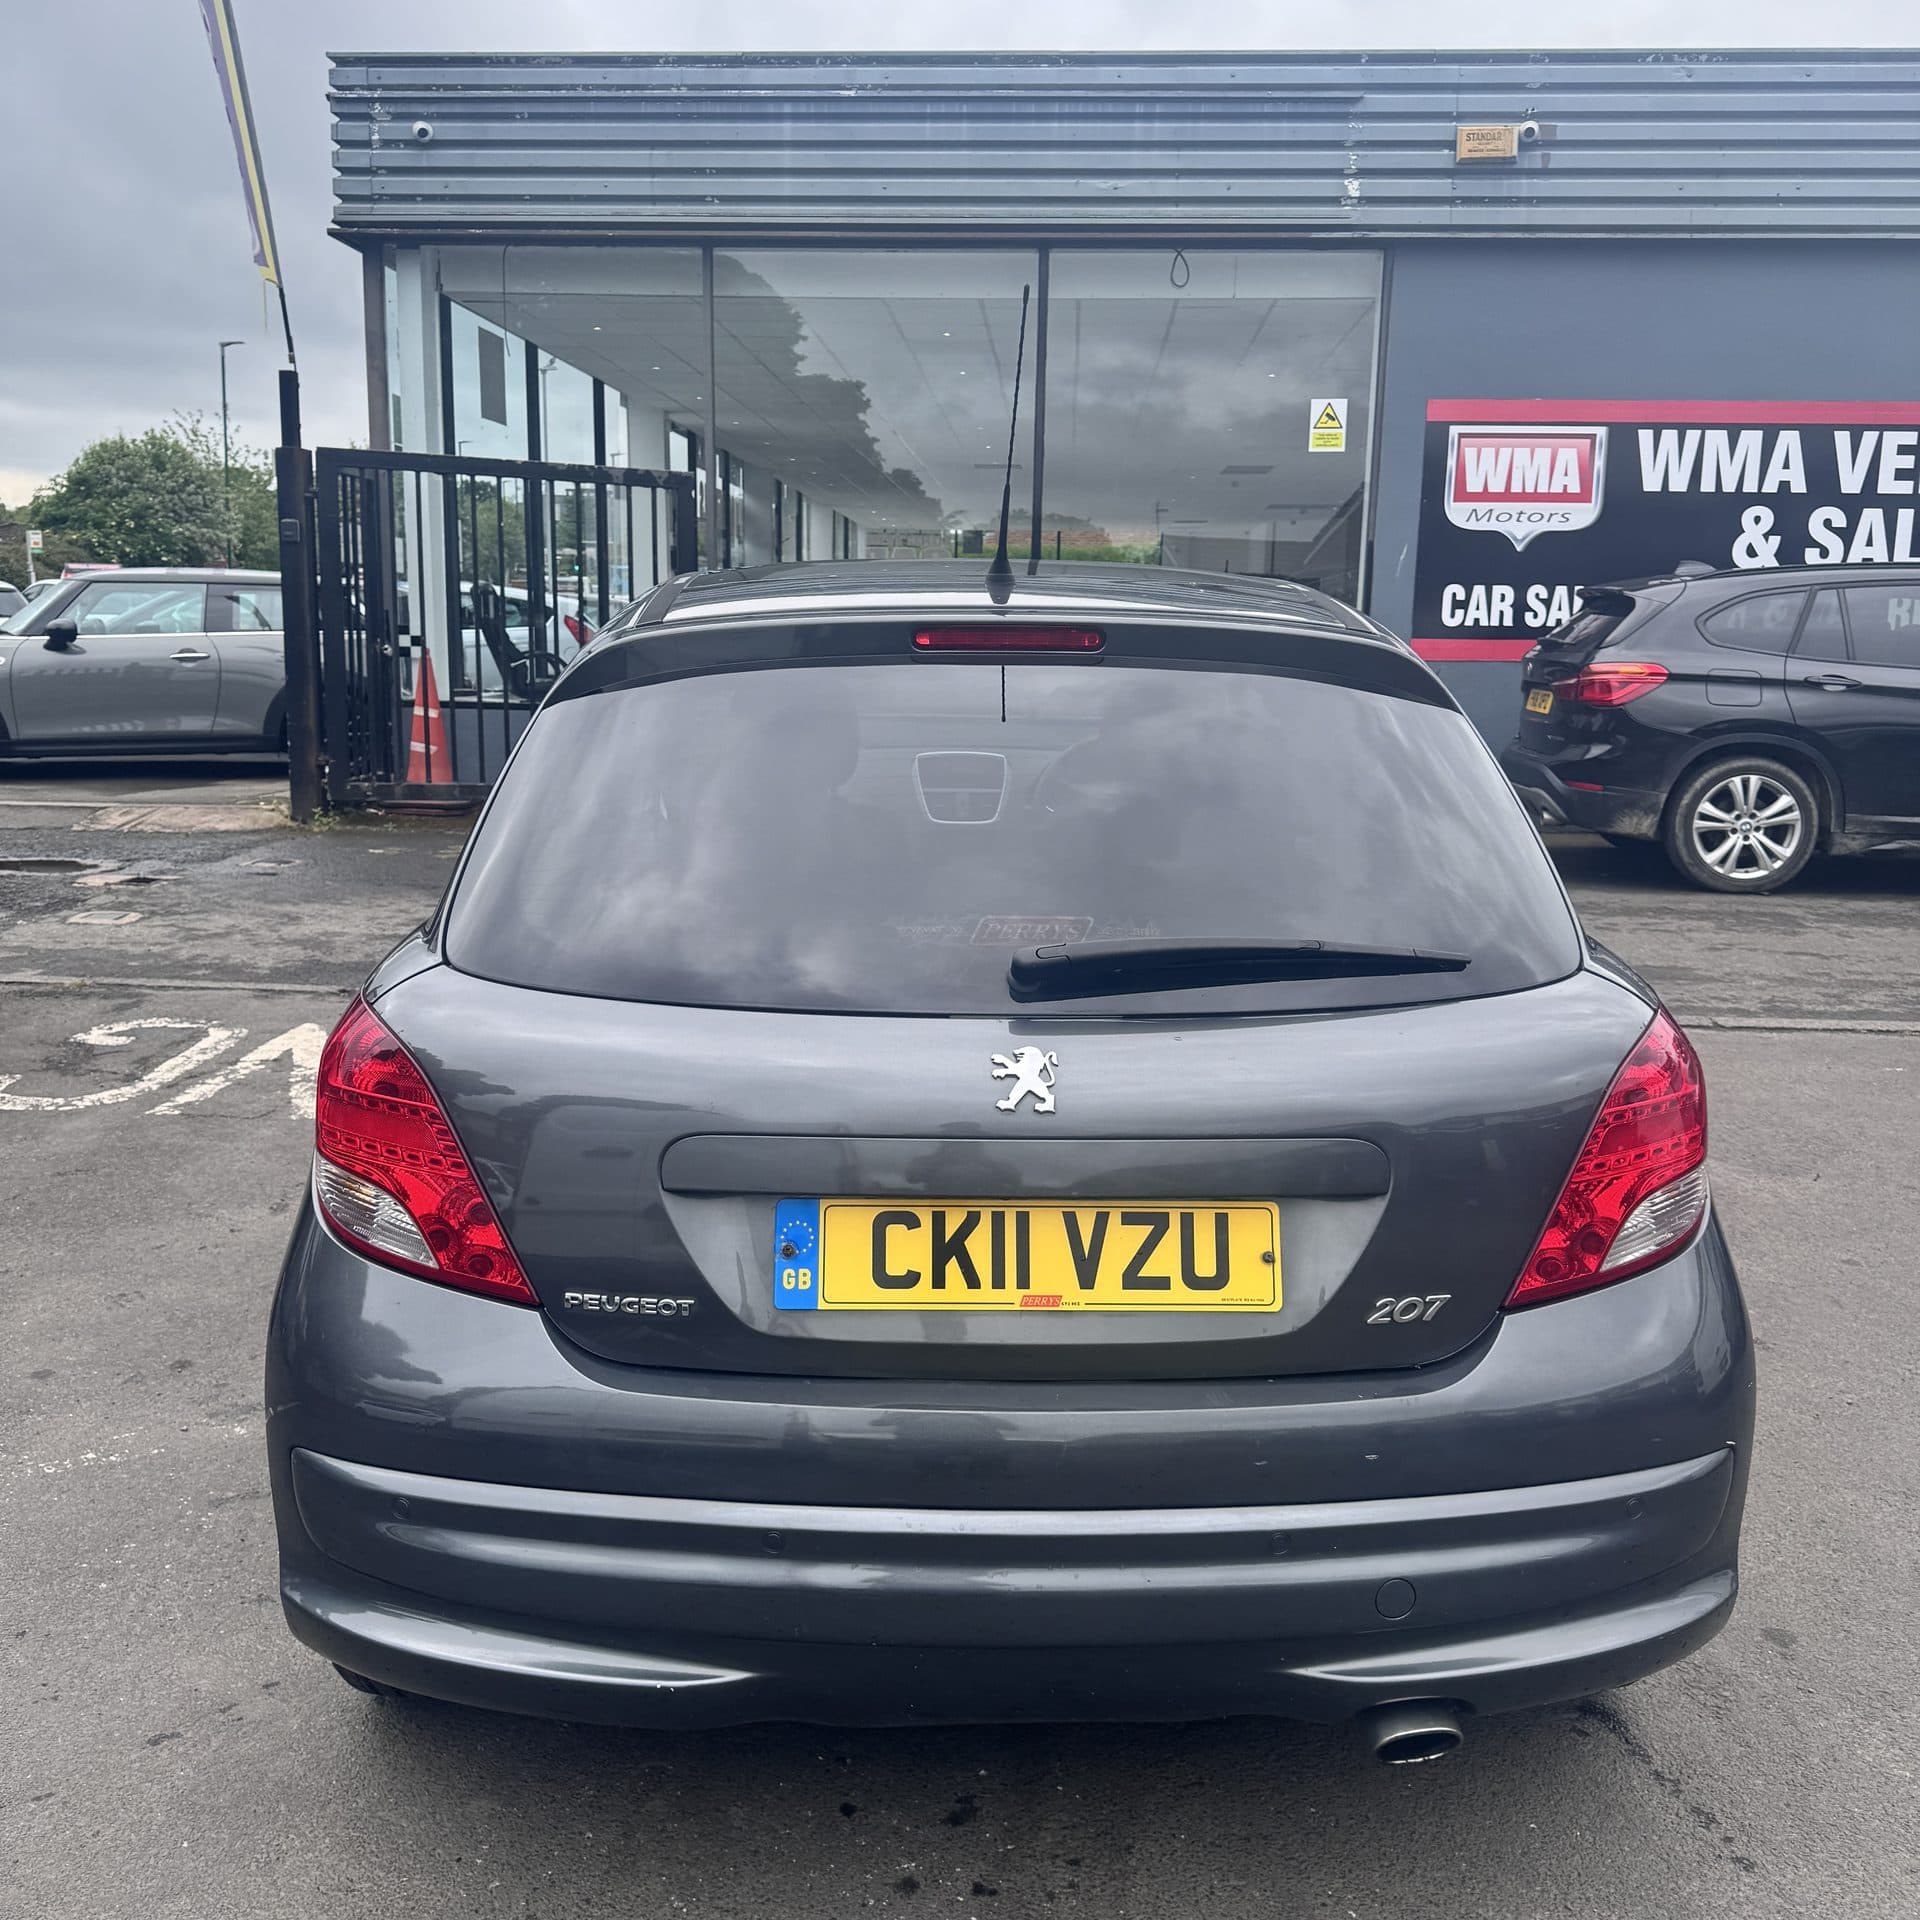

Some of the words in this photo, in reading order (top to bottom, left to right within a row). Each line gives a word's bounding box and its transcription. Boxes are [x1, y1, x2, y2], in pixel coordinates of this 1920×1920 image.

[1465, 131, 1505, 142] STANDAR
[1463, 446, 1581, 494] WMA
[1637, 429, 1807, 495] WMA
[1465, 507, 1571, 524] Motors
[1731, 505, 1781, 568] &
[1441, 583, 1515, 628] CAR
[984, 922, 1083, 941] PERRYS
[871, 1210, 1030, 1291] CK11
[1061, 1211, 1231, 1292] VZU
[781, 1267, 812, 1290] GB
[564, 1292, 695, 1317] PEUGEOT
[1022, 1296, 1061, 1306] PERRYS
[1366, 1294, 1452, 1325] 207
